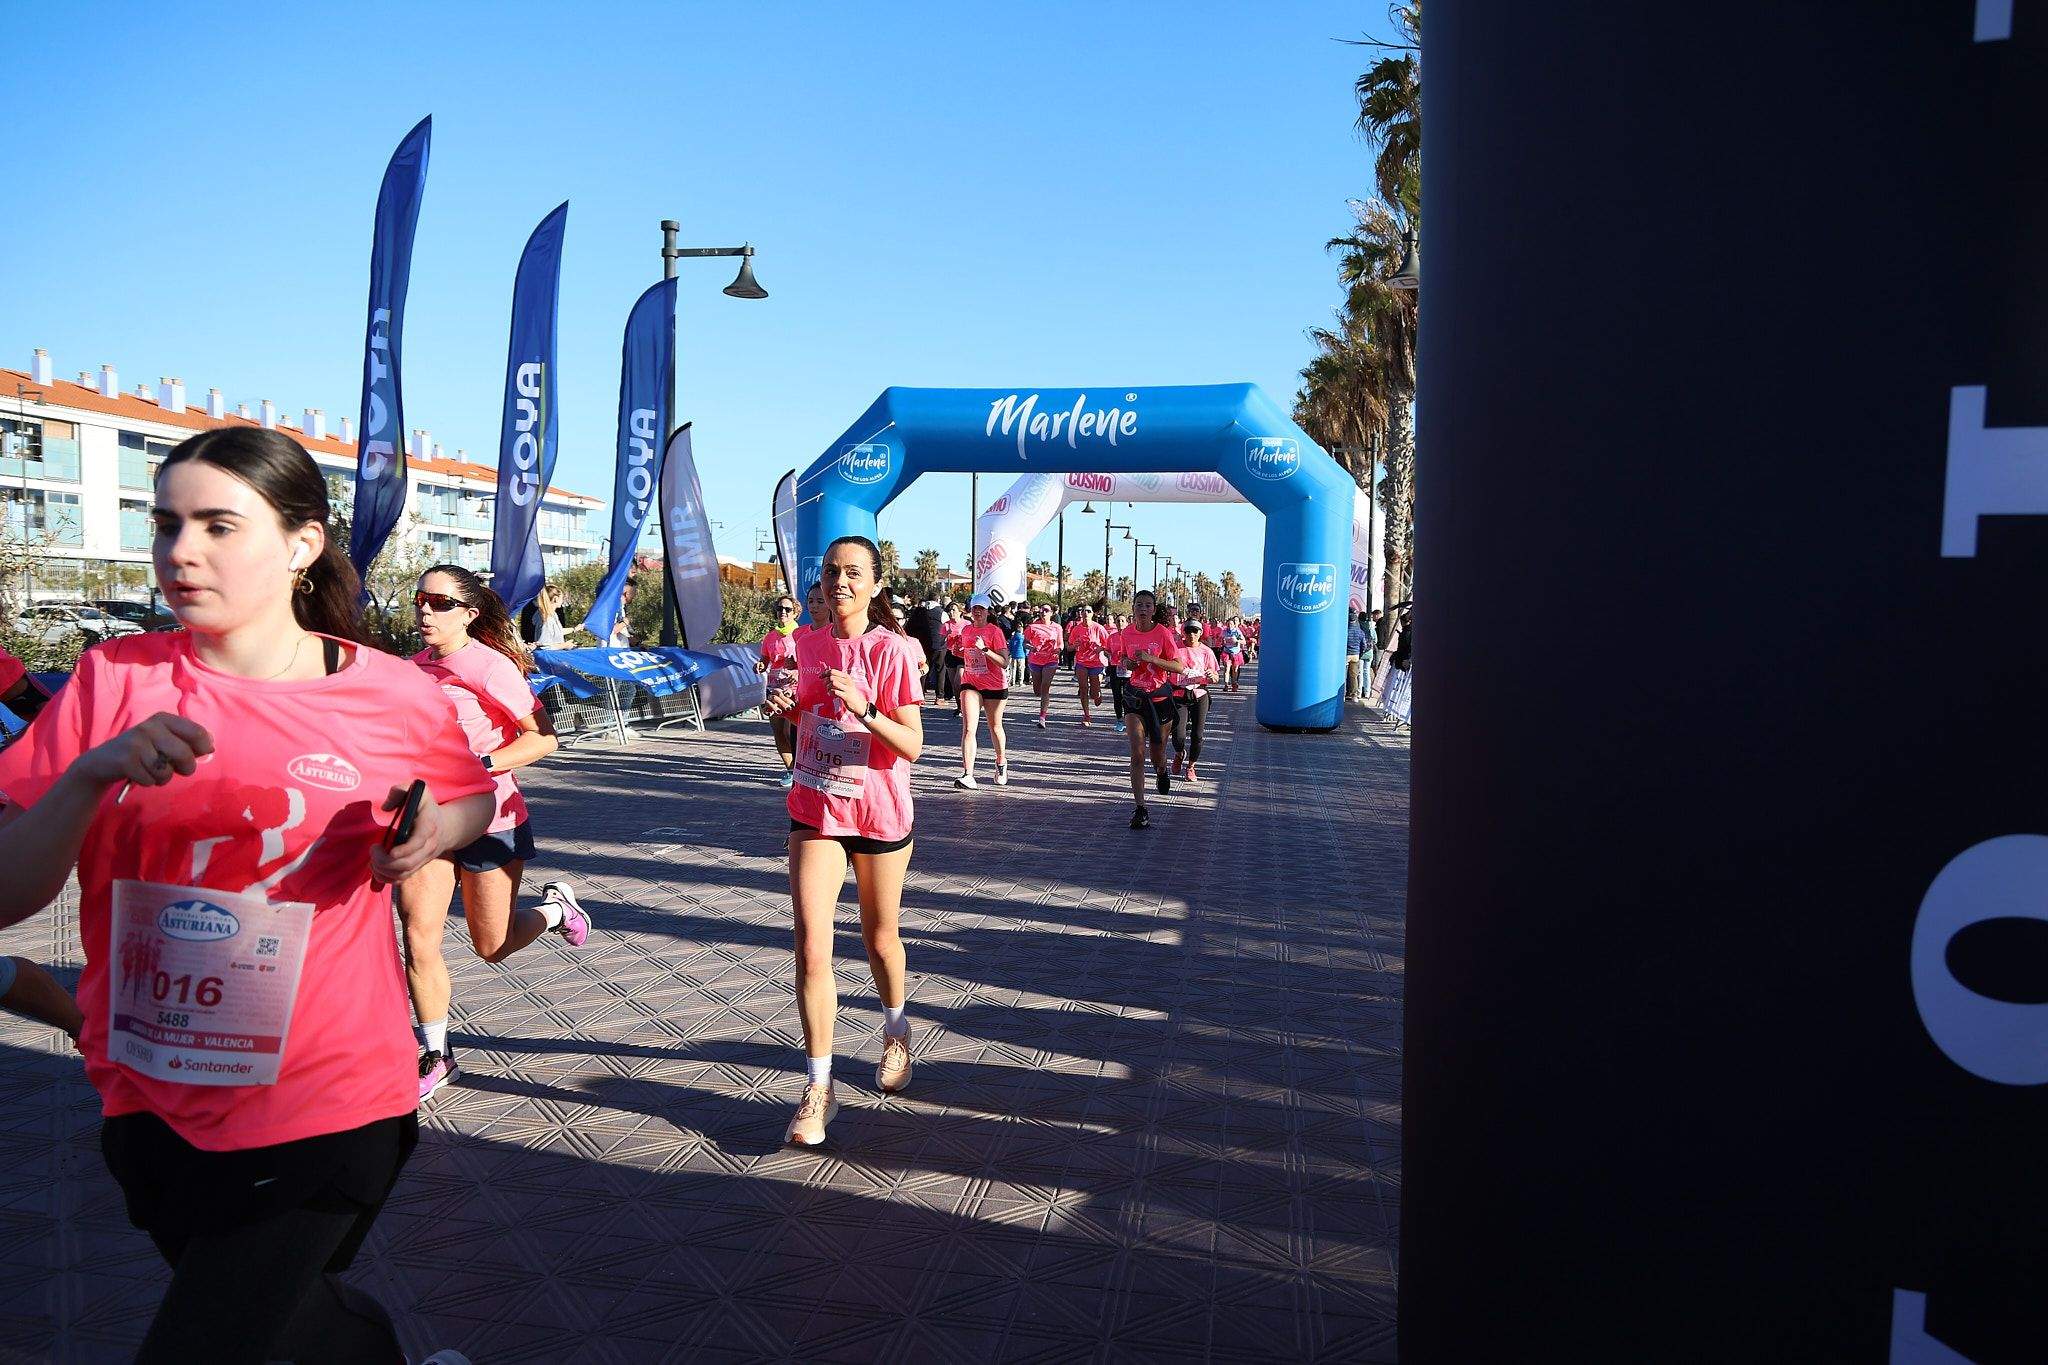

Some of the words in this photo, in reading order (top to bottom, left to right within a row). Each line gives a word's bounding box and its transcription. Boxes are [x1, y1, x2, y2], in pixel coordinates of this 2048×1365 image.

[509, 362, 542, 507] GOYA
[624, 408, 656, 529] GOYA
[1068, 473, 1112, 493] COSMO
[1180, 473, 1226, 494] COSMO
[815, 750, 842, 766] 016
[161, 912, 232, 935] ASTURIANA
[153, 970, 224, 1007] 016
[157, 1011, 190, 1029] 5488
[163, 1032, 195, 1046] MUJER
[204, 1036, 255, 1050] VALENCIA
[183, 1058, 254, 1075] Santander
